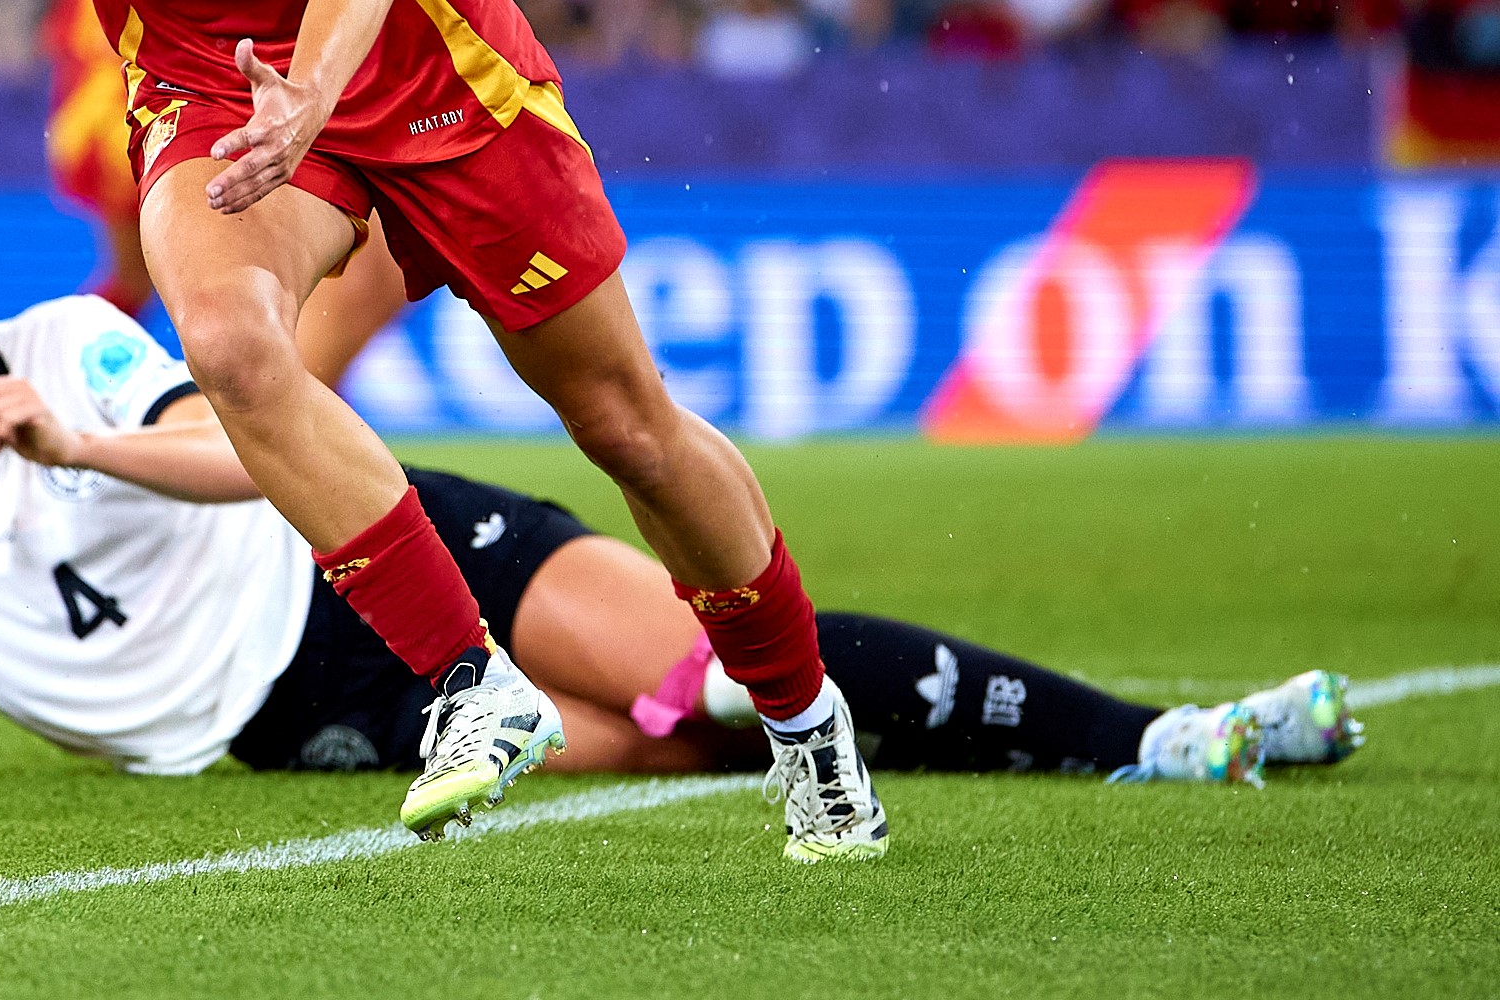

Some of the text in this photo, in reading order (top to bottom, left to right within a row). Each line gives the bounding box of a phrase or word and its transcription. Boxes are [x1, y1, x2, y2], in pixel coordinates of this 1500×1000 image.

[409, 109, 464, 135] HEAT.RDY
[958, 225, 1318, 432] on
[52, 560, 128, 640] 4
